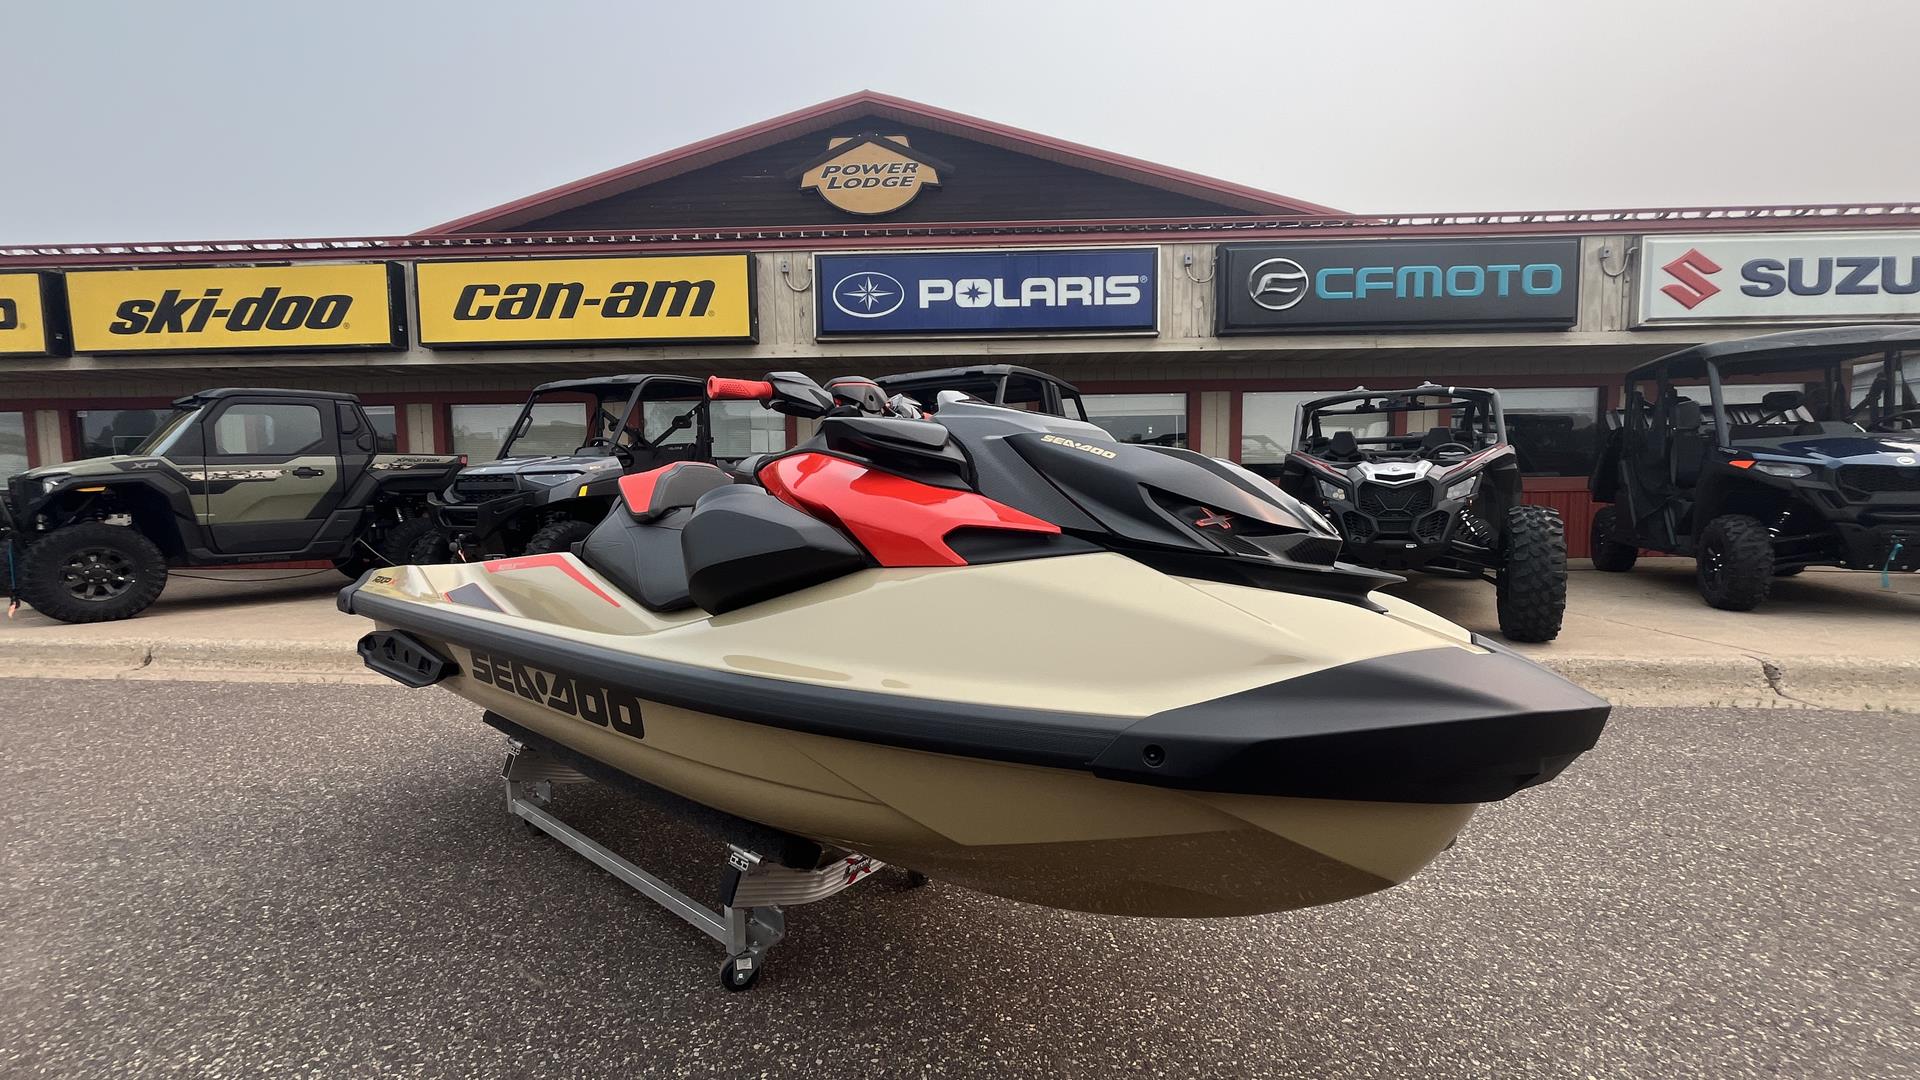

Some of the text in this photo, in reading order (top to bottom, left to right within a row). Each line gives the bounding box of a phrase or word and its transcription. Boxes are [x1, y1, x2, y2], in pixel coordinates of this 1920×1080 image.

[821, 163, 919, 178] POWER
[827, 176, 915, 189] LODGE
[919, 275, 1141, 309] POLARIS
[1315, 263, 1562, 299] CFMOTO
[109, 287, 354, 335] ski-doo
[453, 280, 716, 321] can-am
[131, 461, 159, 469] XP
